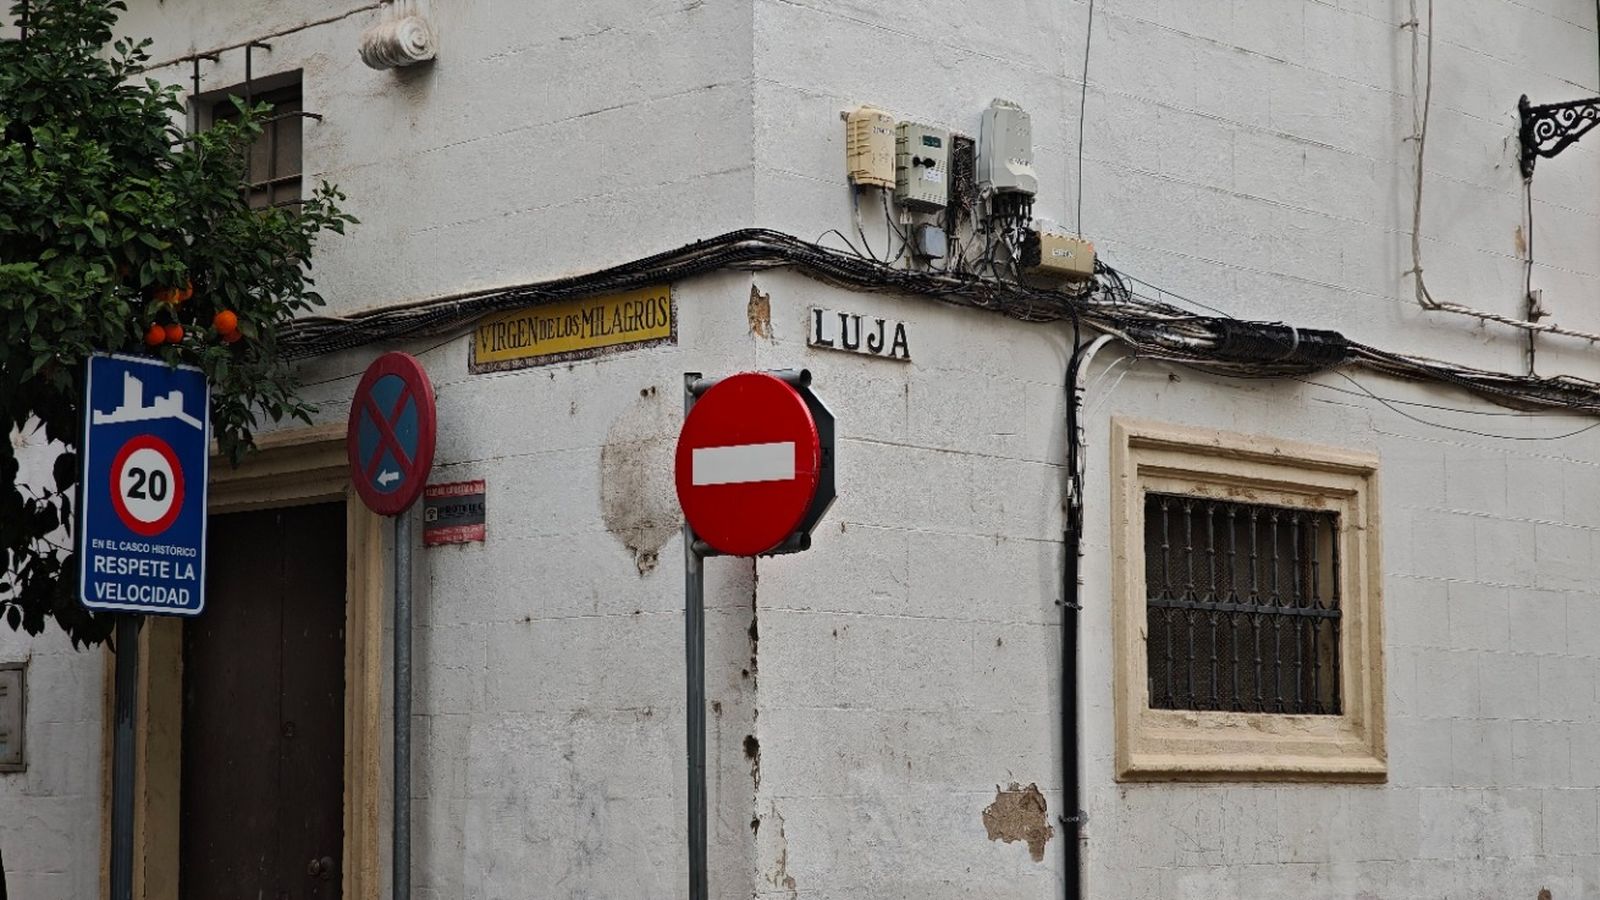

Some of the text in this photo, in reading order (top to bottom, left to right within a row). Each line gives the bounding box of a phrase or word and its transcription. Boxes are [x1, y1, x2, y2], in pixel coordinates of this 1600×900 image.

[479, 296, 669, 354] VIRGEN DE LOS MILAGROS
[812, 308, 910, 358] LUJA
[127, 467, 167, 502] 20
[92, 538, 197, 558] EN EL CASCO HISTÓRICO
[94, 555, 195, 581] RESPETE LA
[94, 581, 190, 606] VELOCIDAD
